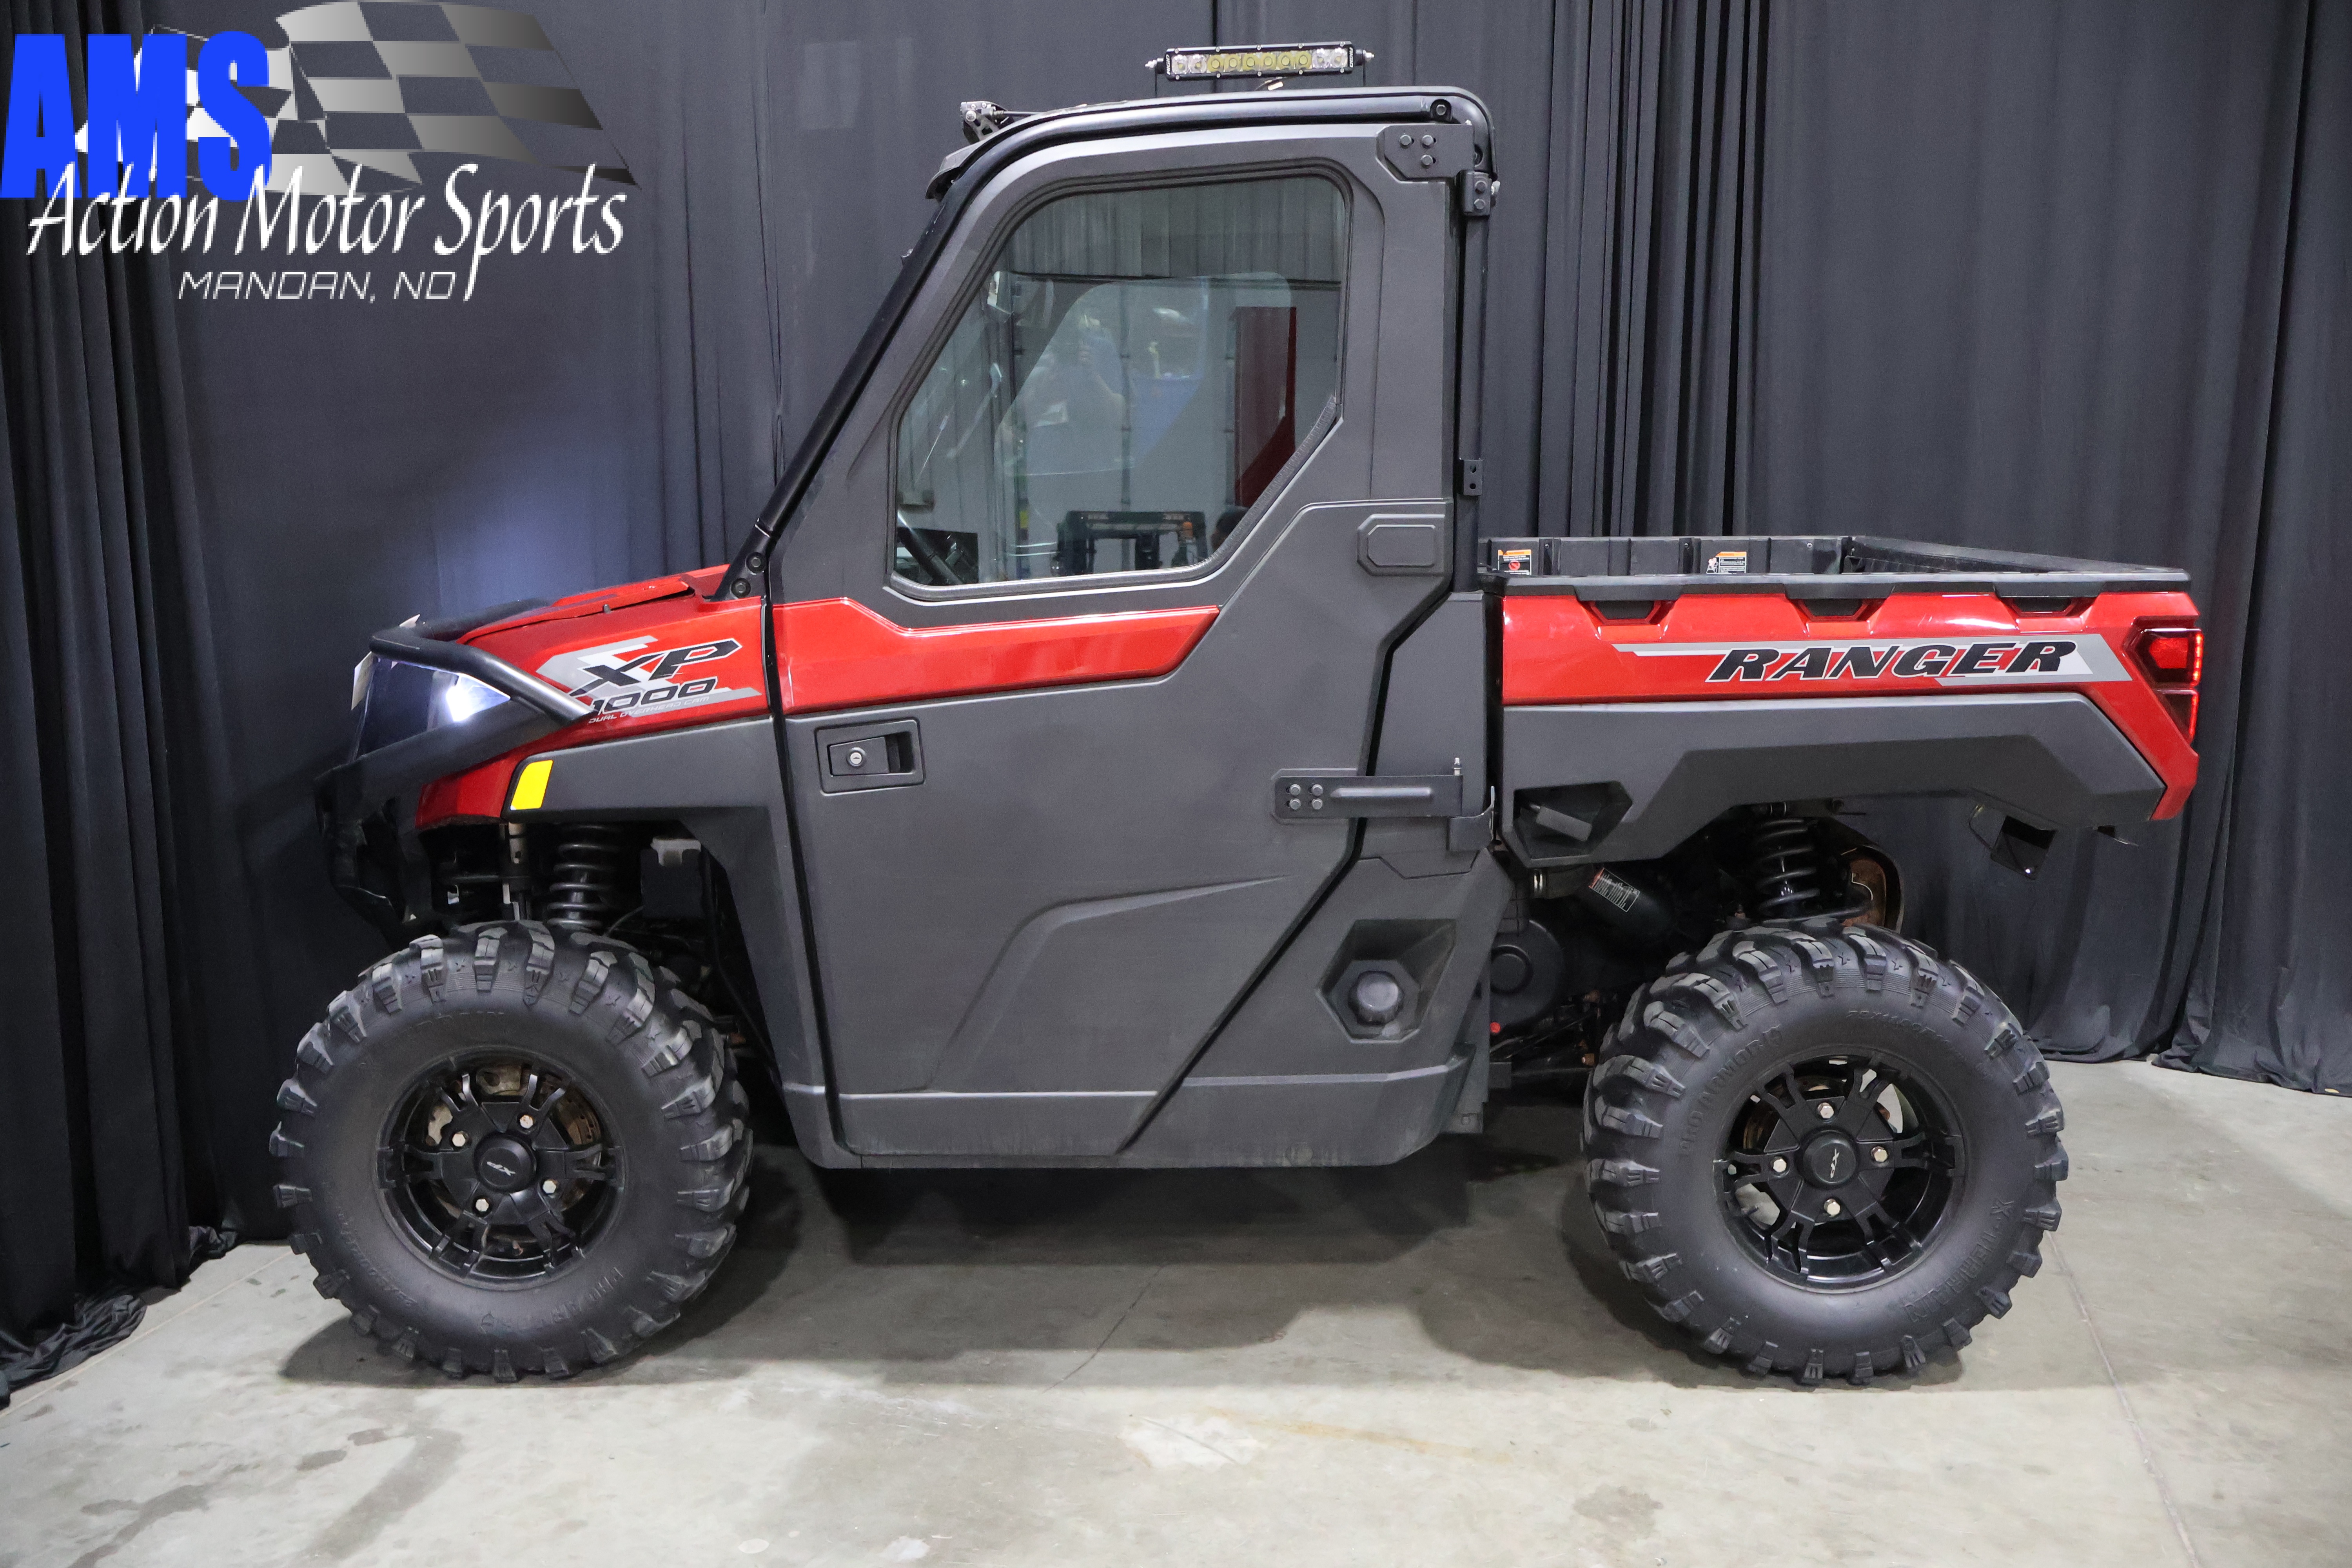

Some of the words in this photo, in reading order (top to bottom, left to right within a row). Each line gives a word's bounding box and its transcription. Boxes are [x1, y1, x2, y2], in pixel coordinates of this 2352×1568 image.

[568, 638, 742, 697] XP
[1705, 641, 2078, 682] RANGER
[588, 713, 617, 724] DUAL
[619, 702, 682, 717] OVERHEAD
[684, 695, 710, 706] CAM
[592, 676, 718, 716] 1000
